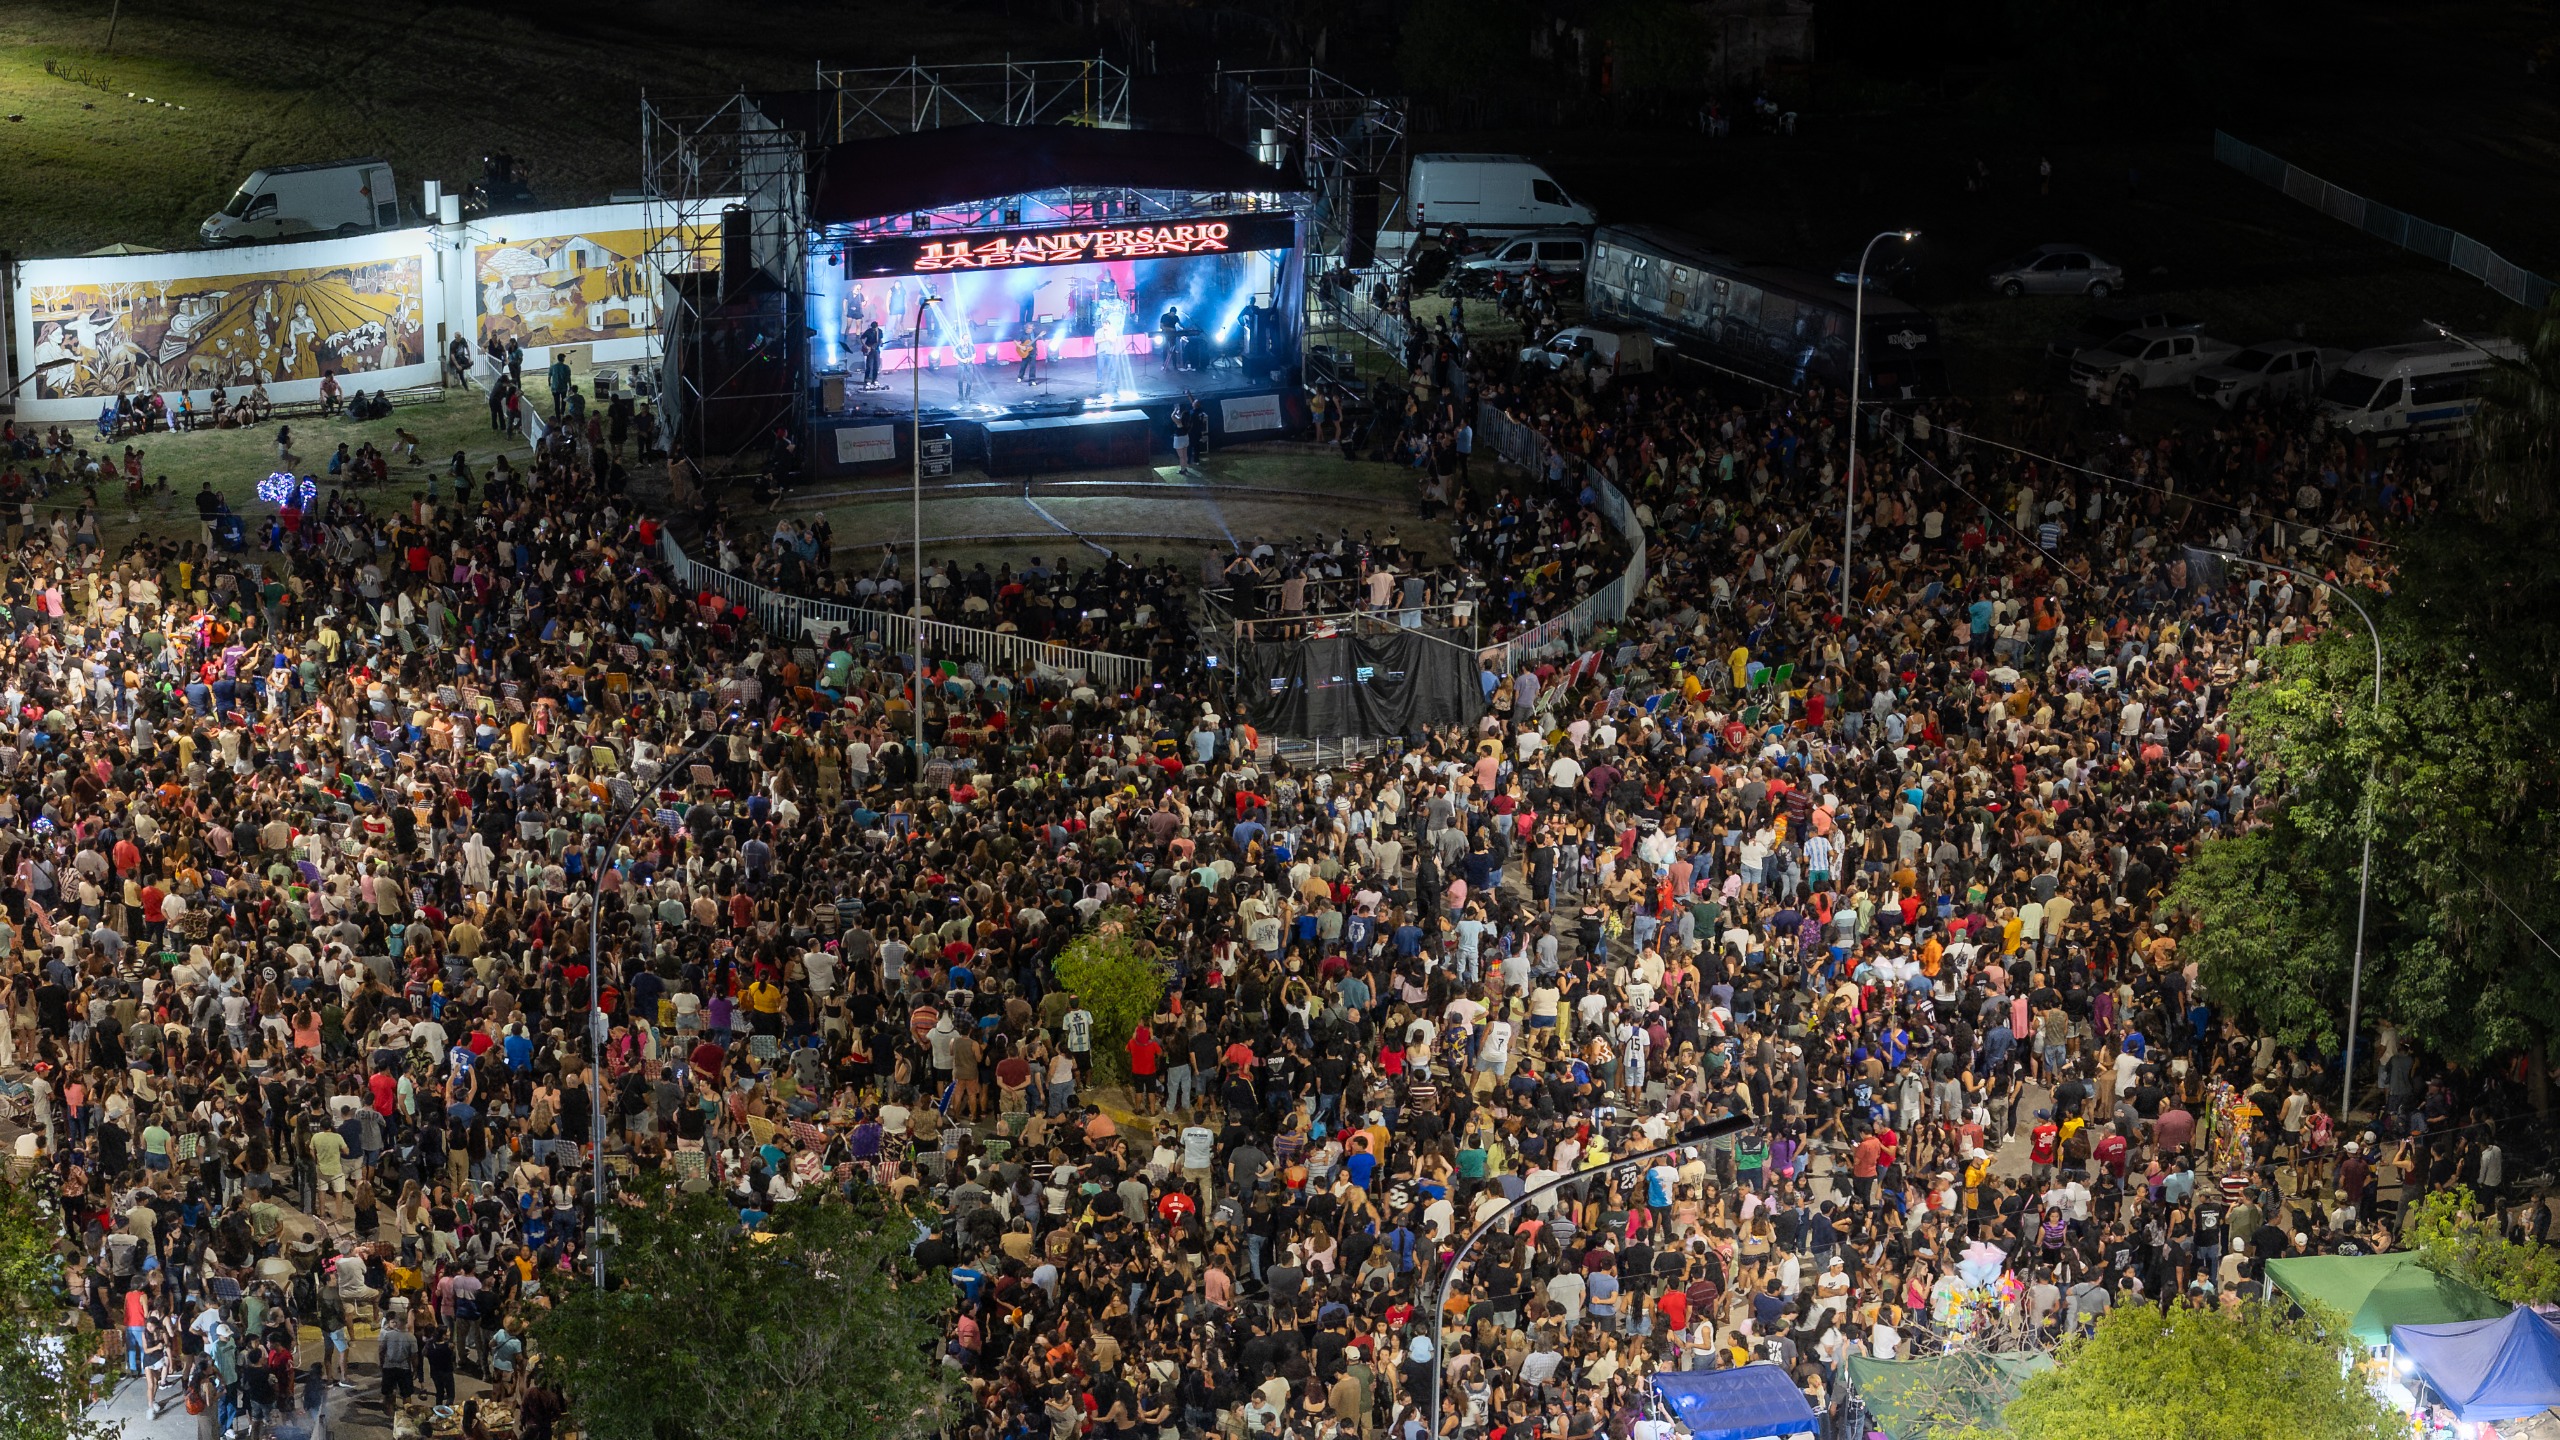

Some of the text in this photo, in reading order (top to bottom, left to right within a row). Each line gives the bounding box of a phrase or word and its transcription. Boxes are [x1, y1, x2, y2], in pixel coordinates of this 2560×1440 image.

[921, 223, 1229, 259] 114 ANIVERSARIO
[914, 239, 1229, 271] SAENZ PENA
[1733, 730, 1742, 745] 10
[1258, 924, 1276, 933] NEW
[445, 957, 464, 965] NASA
[1636, 997, 1643, 1011] 9
[1073, 1023, 1086, 1035] 10
[1498, 1038, 1505, 1051] 7
[1631, 1038, 1640, 1051] 15
[1725, 1047, 1732, 1062] 5
[1621, 1171, 1637, 1189] 23
[1172, 1209, 1182, 1224] 7
